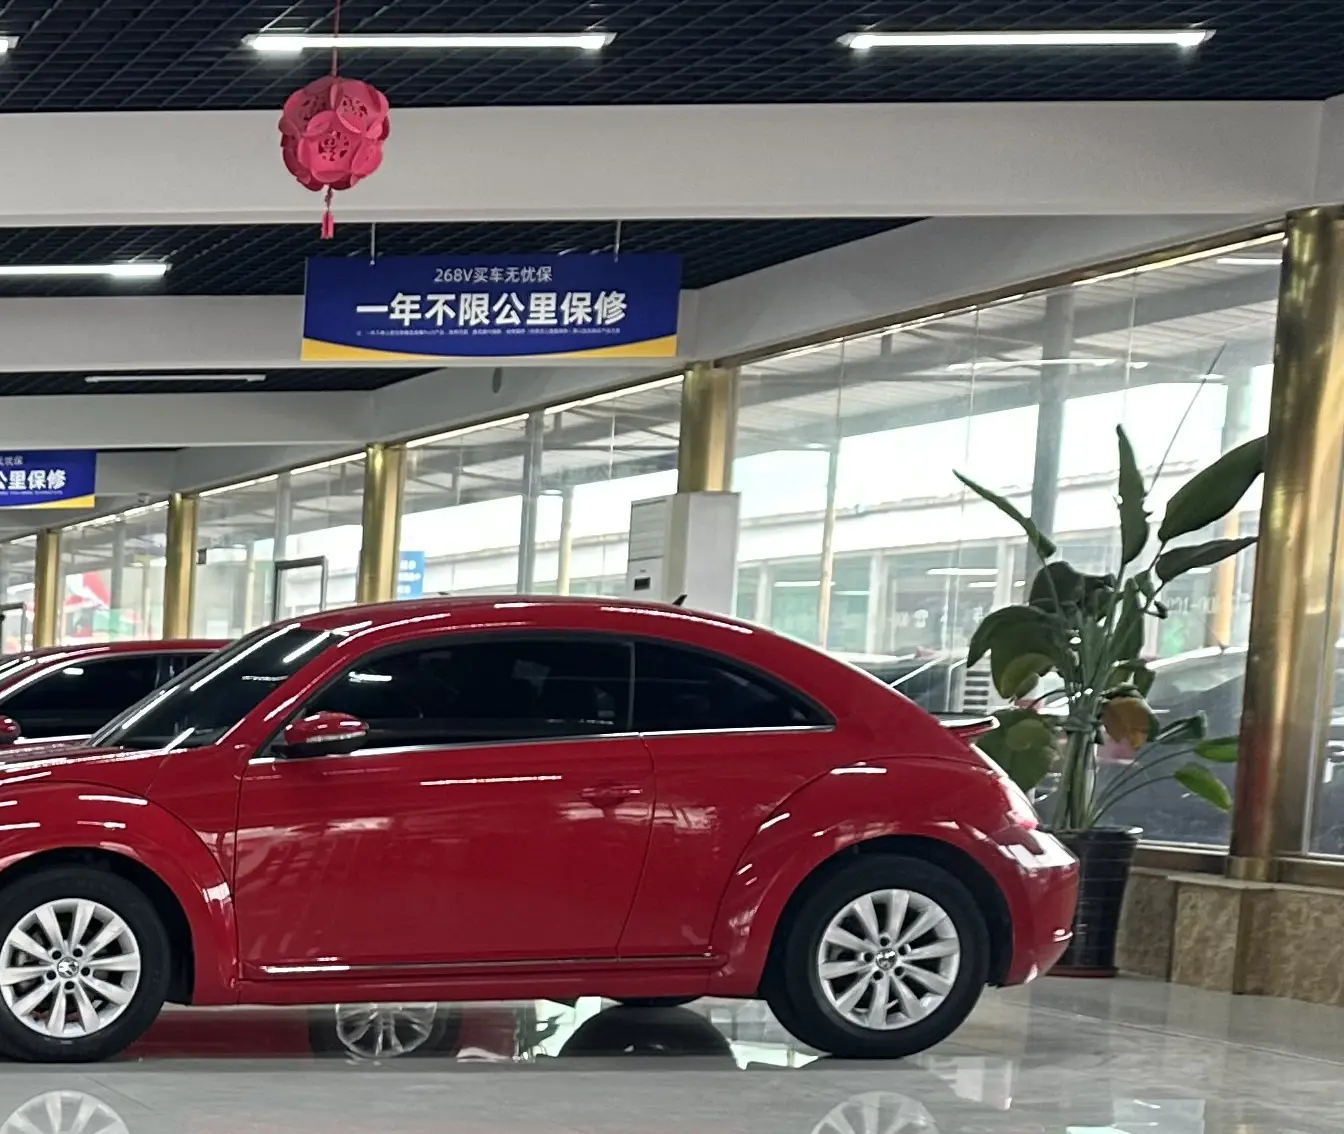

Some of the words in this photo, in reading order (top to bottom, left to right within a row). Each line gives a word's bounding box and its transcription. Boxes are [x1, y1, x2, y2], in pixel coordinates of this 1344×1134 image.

[434, 266, 552, 283] 268V买车无忧保
[356, 291, 627, 327] 一年不限公里保修
